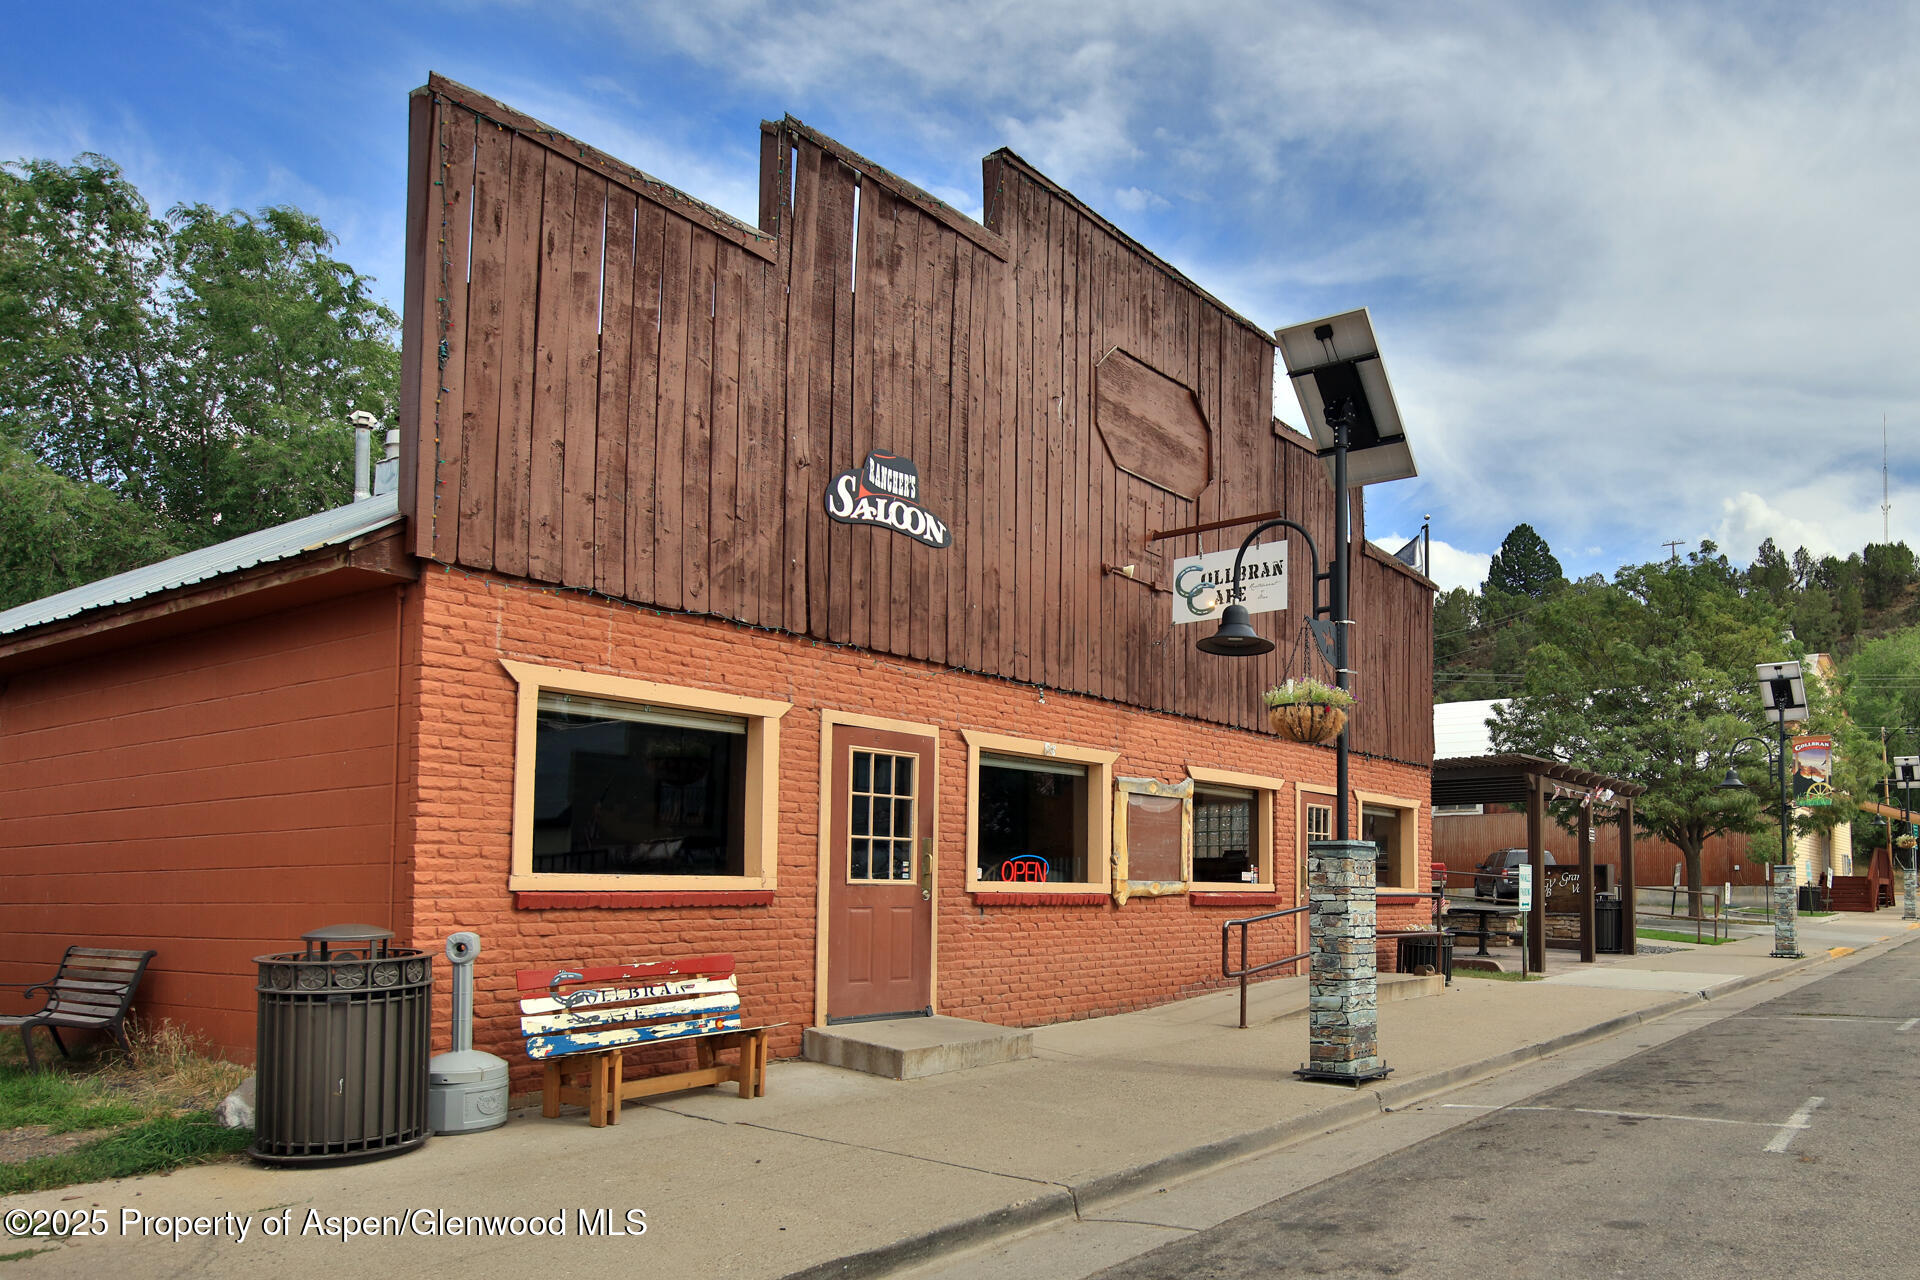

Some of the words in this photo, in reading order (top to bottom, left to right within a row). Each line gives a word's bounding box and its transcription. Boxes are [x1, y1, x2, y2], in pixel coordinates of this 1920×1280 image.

[869, 457, 916, 499] RANCHER'S
[829, 474, 947, 544] SALOON
[1001, 860, 1047, 882] OPEN
